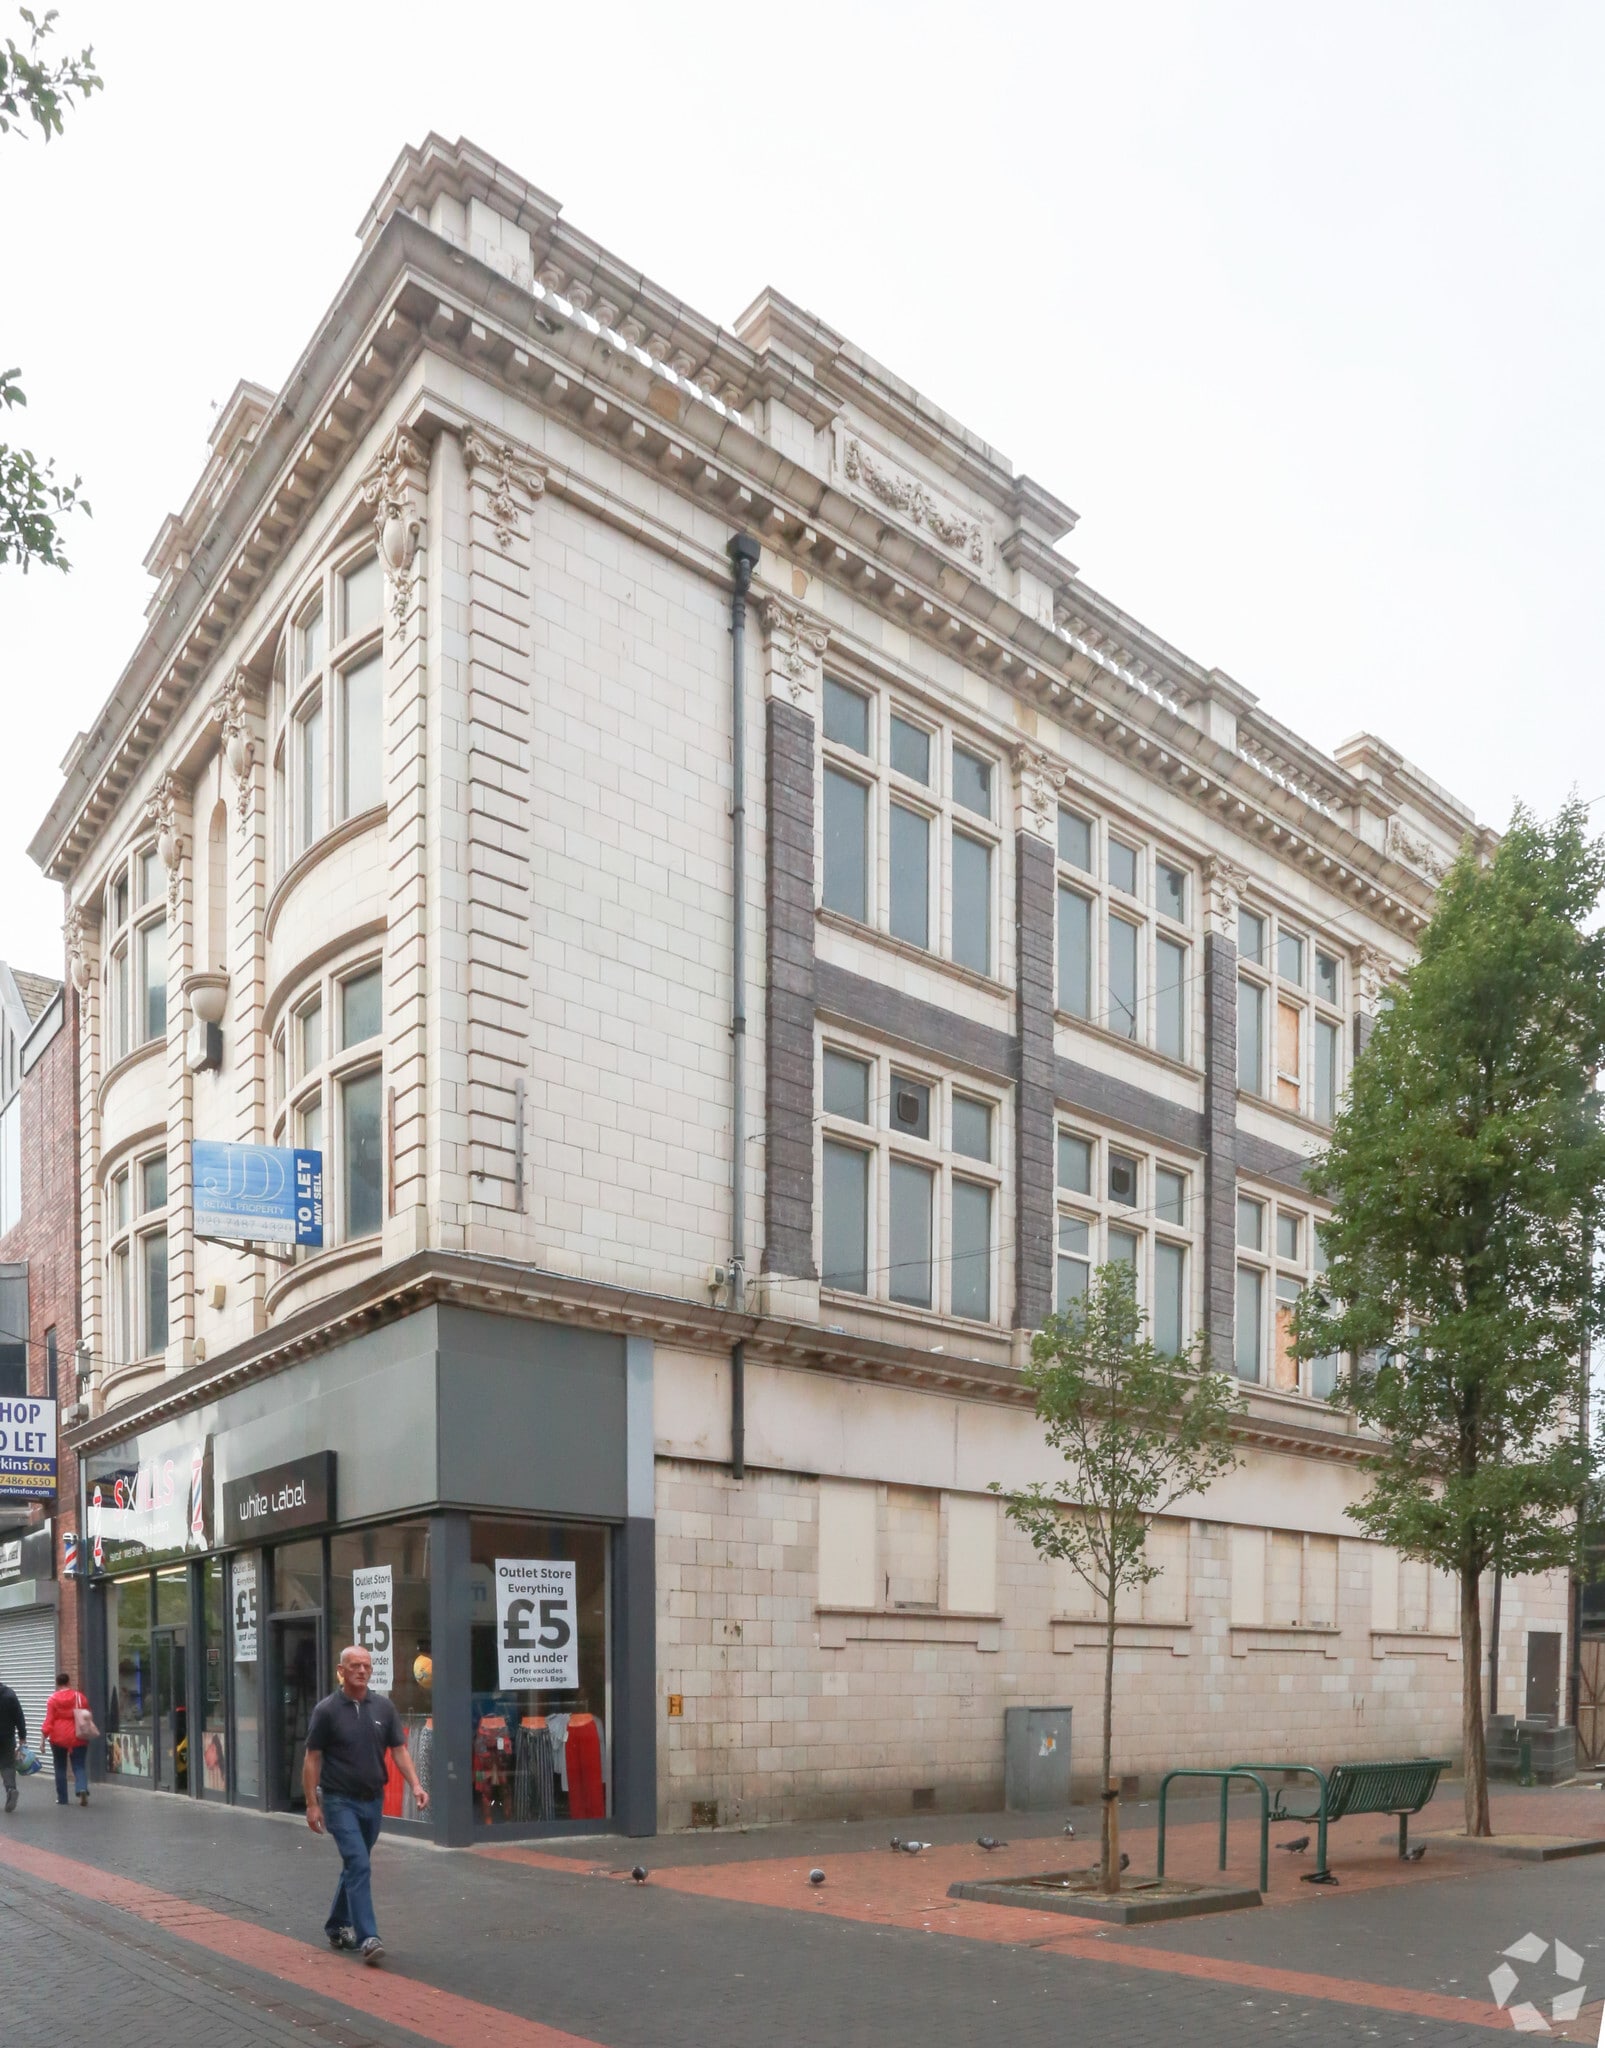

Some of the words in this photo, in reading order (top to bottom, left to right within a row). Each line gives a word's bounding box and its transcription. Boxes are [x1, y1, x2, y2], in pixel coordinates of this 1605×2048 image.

[297, 1158, 312, 1199] LET
[313, 1173, 322, 1199] SELL
[203, 1199, 235, 1211] RETAIL
[236, 1202, 285, 1215] PROPERTY
[313, 1202, 323, 1226] MAY
[298, 1207, 312, 1235] TO
[0, 1402, 41, 1424] HOP
[0, 1430, 8, 1450] O
[15, 1431, 47, 1453] LET
[0, 1457, 51, 1472] kinsfox
[0, 1475, 24, 1485] 7486
[26, 1477, 51, 1487] 6550
[355, 1576, 373, 1586] Outlet
[373, 1574, 391, 1584] Store
[499, 1567, 538, 1579] Outlet
[540, 1568, 572, 1579] Store
[360, 1590, 386, 1601] Everything
[508, 1584, 564, 1595] Everything
[357, 1604, 390, 1652] £5
[503, 1598, 571, 1649] £5
[372, 1656, 389, 1665] under
[507, 1653, 530, 1663] and
[533, 1653, 568, 1663] under
[513, 1667, 531, 1675] Offer
[533, 1667, 563, 1675] excludes
[510, 1676, 543, 1684] Footwear
[550, 1676, 567, 1684] Bags
